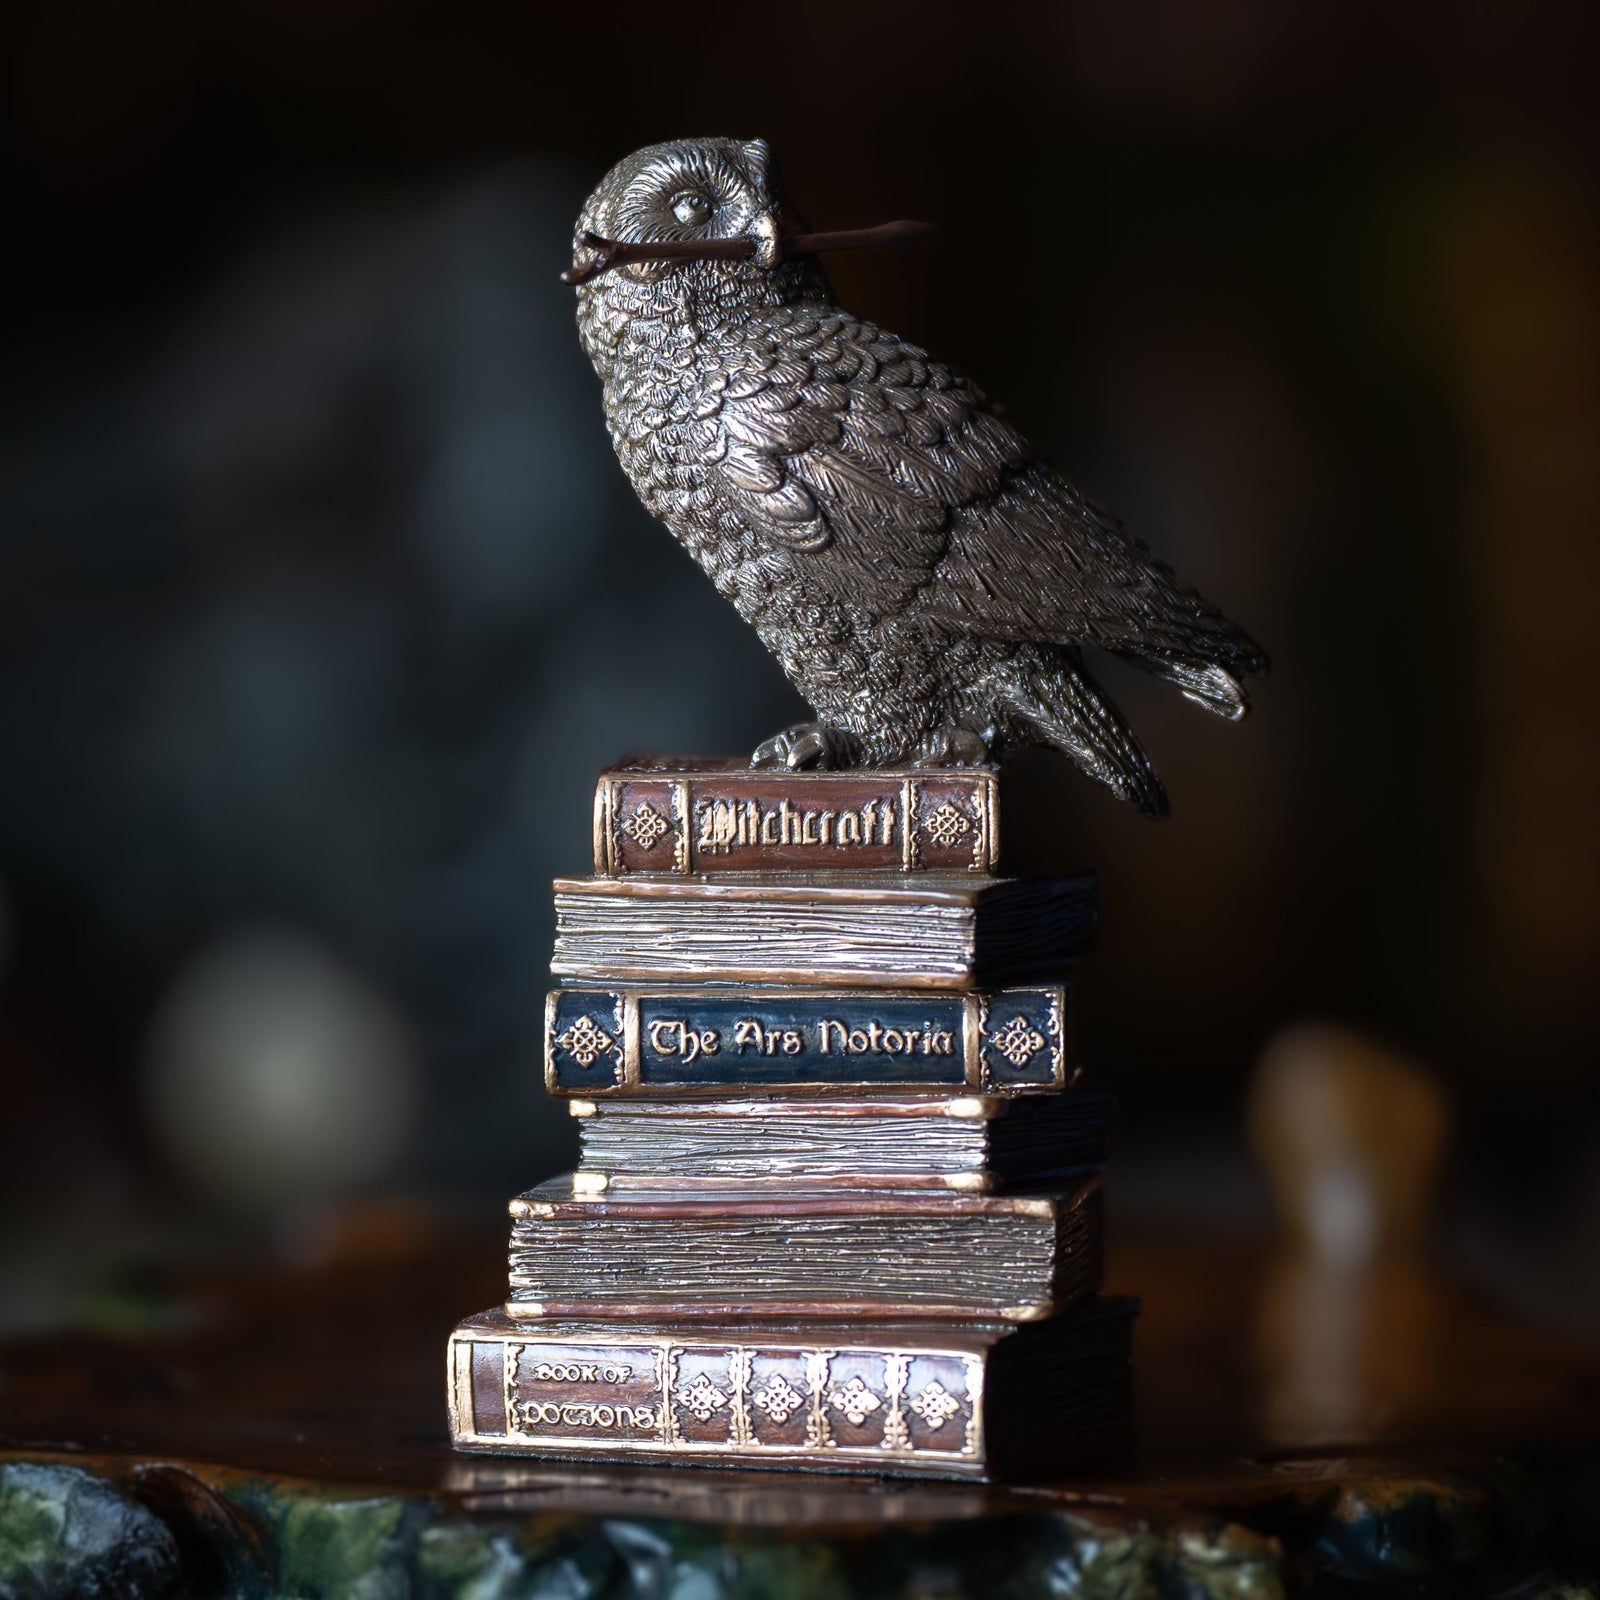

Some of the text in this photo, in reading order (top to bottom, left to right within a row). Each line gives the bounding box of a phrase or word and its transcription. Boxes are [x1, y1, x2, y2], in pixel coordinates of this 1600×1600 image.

[698, 798, 896, 854] Witchcraft
[647, 1015, 954, 1064] The Ars Notoria
[535, 1363, 633, 1384] BOOK OF
